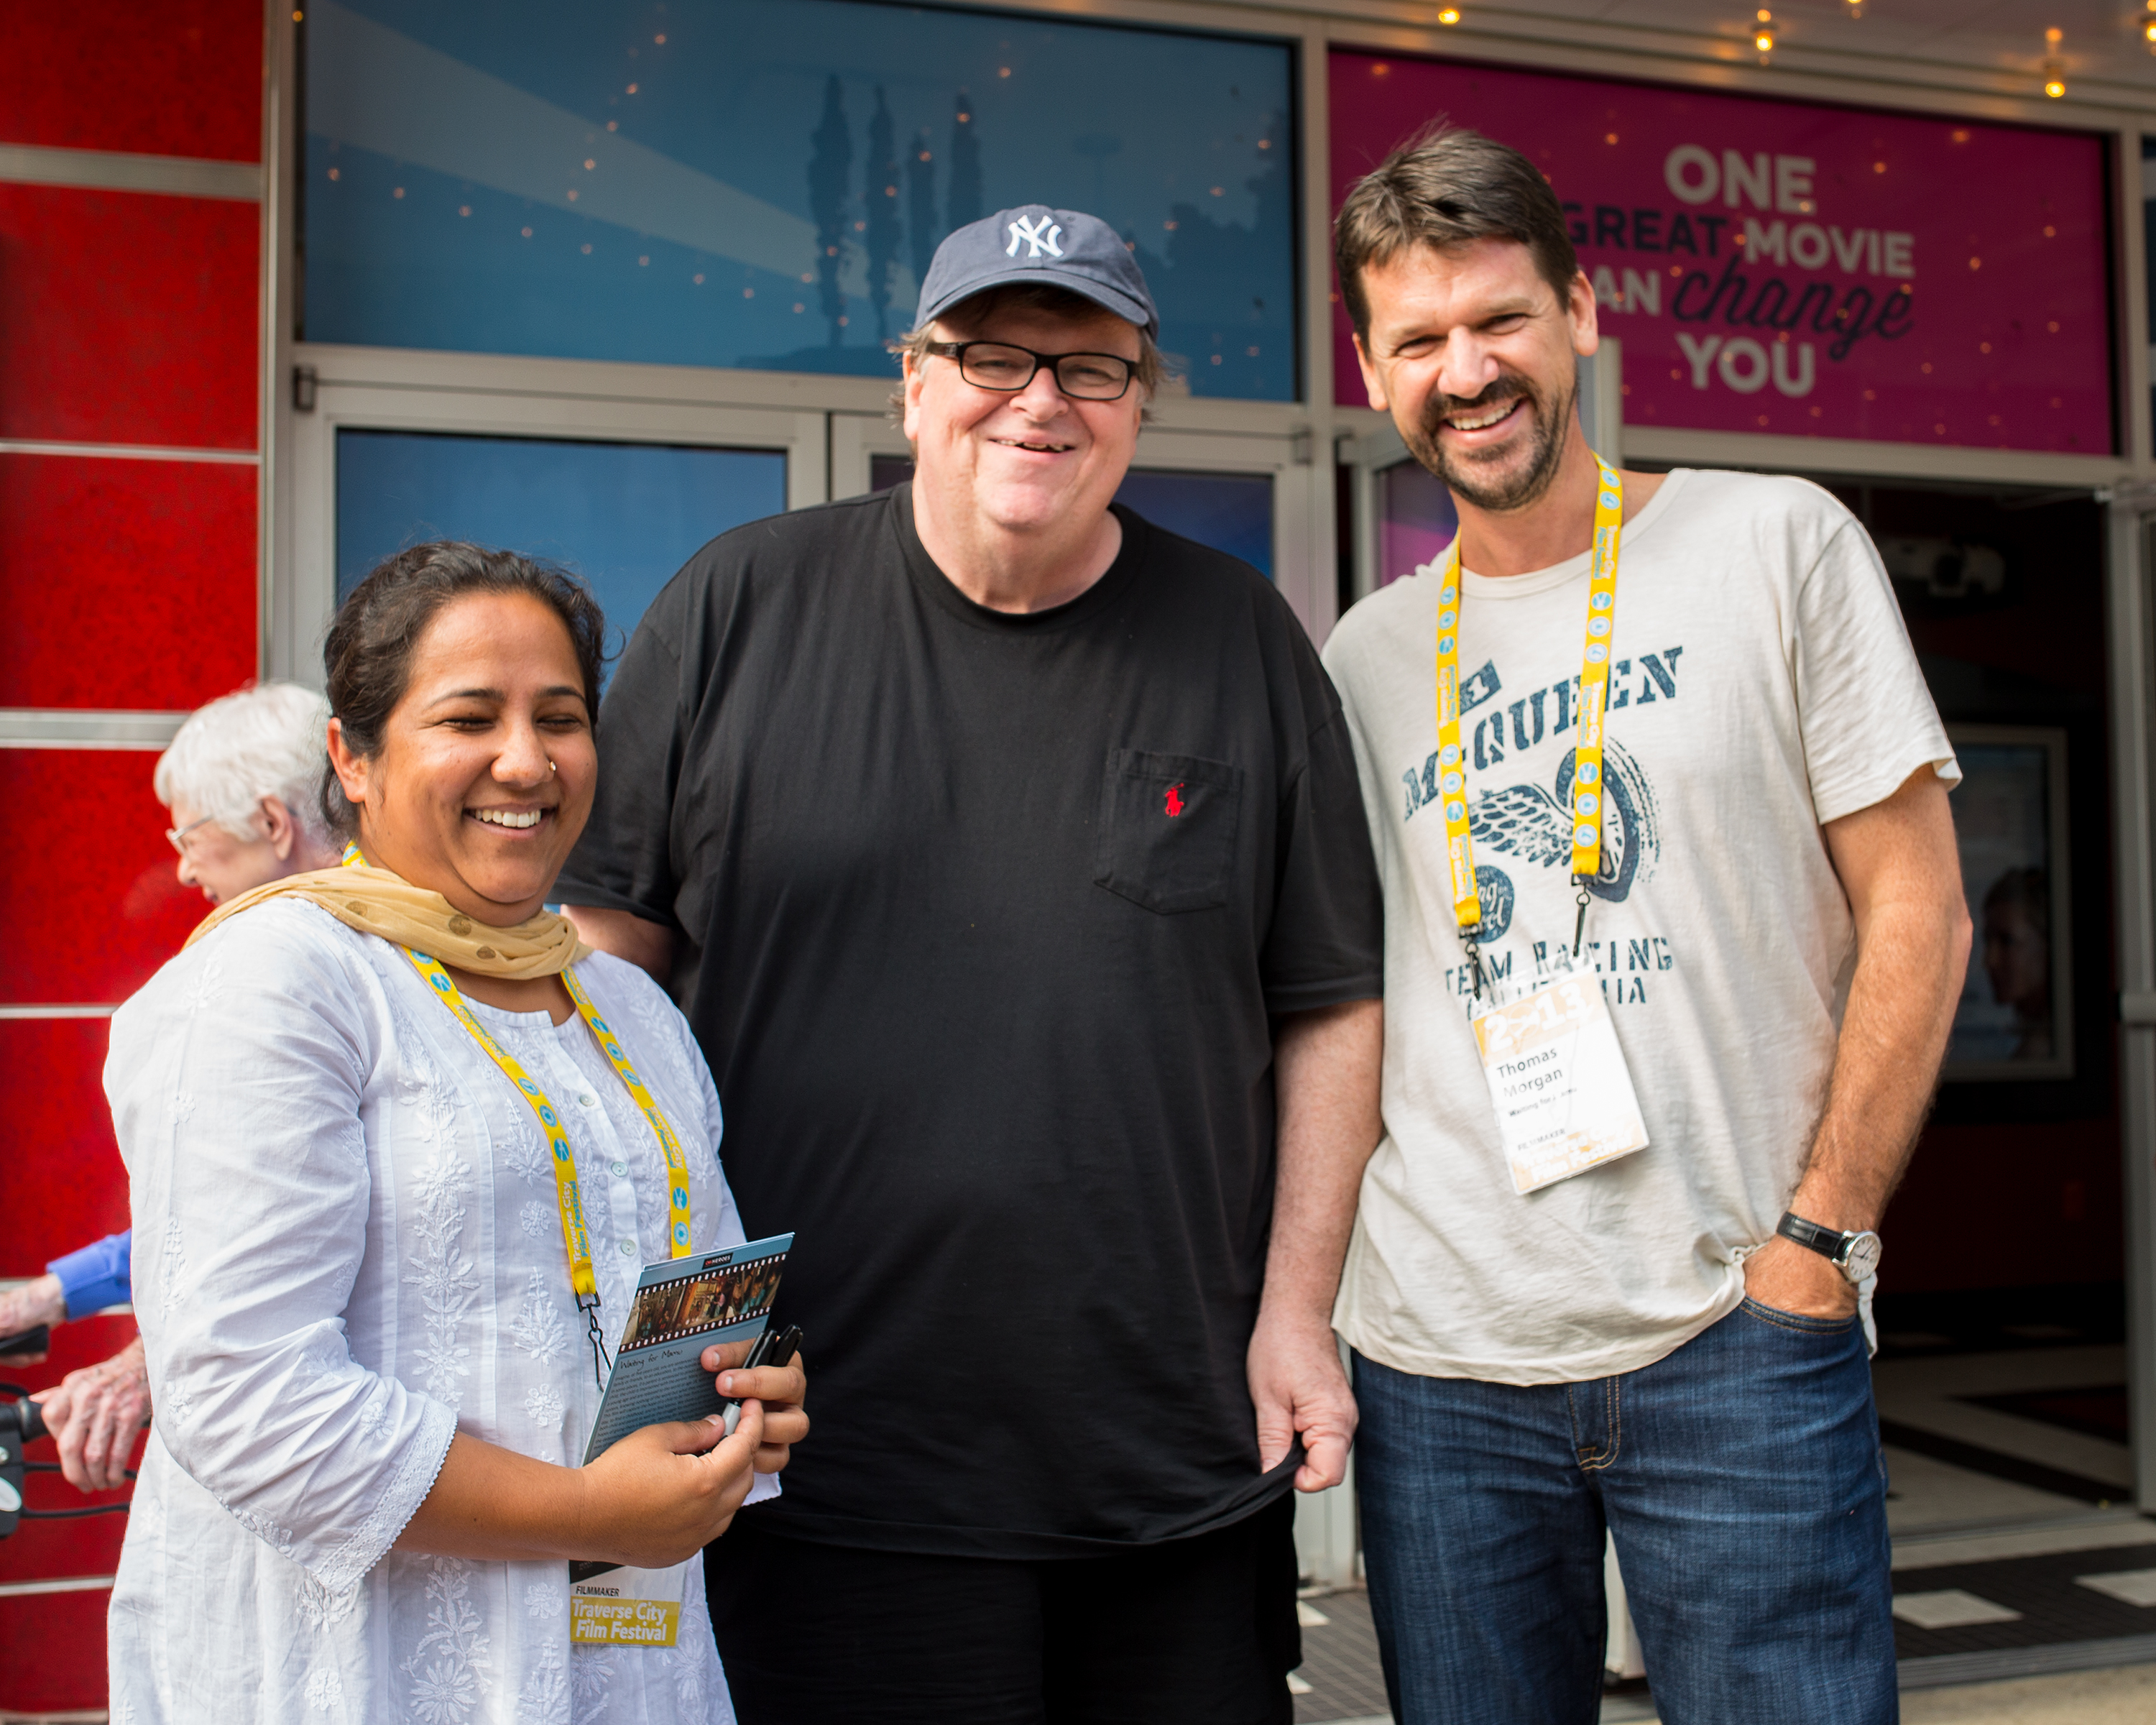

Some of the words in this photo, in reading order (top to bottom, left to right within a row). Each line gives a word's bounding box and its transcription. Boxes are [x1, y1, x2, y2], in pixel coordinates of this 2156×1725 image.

[1664, 144, 1816, 215] ONE
[1005, 214, 1064, 258] NY
[1561, 201, 1729, 257] GREAT
[1744, 218, 1915, 279] MOVIE
[1590, 264, 1661, 316] AN
[1672, 254, 1914, 362] change
[1676, 333, 1816, 397] YOU
[1497, 1048, 1557, 1078] Thomas
[1503, 1069, 1563, 1098] Morgan
[563, 1181, 572, 1209] City
[569, 1180, 583, 1228] Festival
[566, 1211, 582, 1264] Traverse
[579, 1231, 589, 1258] Film
[648, 1353, 659, 1363] for
[576, 1586, 619, 1597] FILMMAKER
[572, 1598, 633, 1619] Traverse
[636, 1601, 667, 1627] City
[576, 1619, 607, 1639] Film
[611, 1622, 667, 1641] Festival
